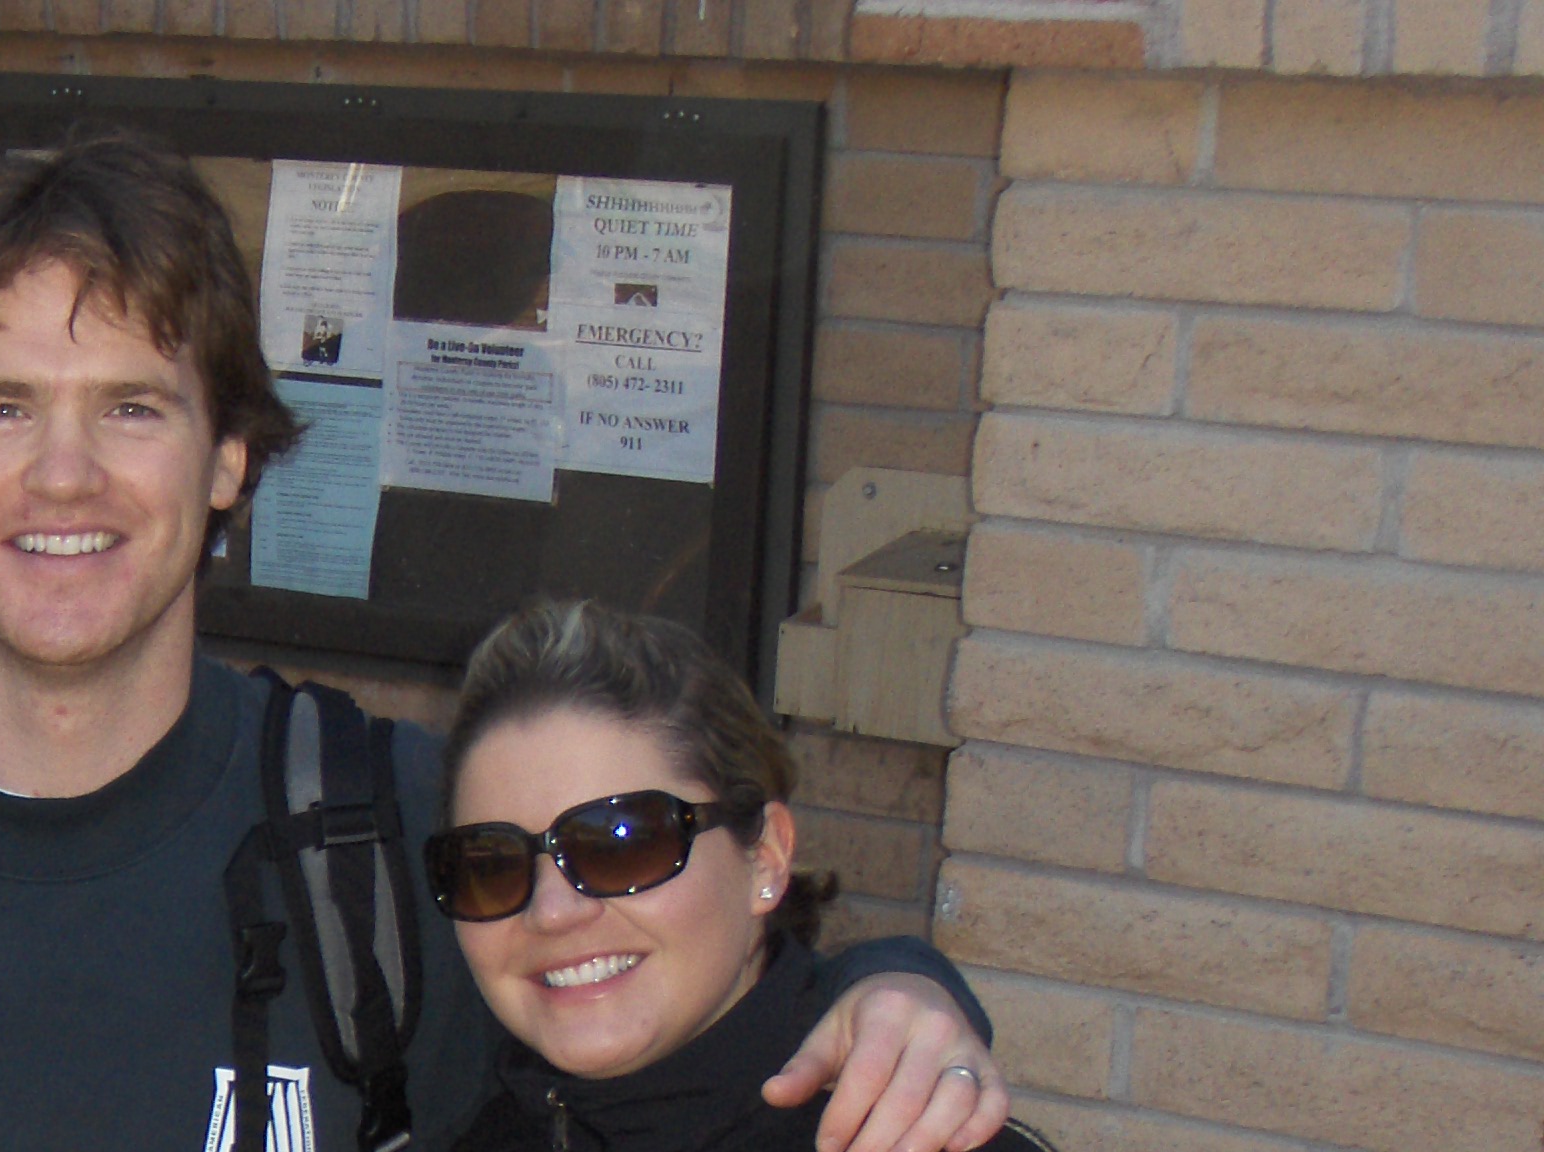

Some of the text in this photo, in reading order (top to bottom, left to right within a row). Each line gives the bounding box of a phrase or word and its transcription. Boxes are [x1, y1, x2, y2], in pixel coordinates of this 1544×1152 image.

[594, 217, 699, 238] QUIET TIME
[596, 244, 610, 260] 10
[614, 246, 638, 261] PM
[652, 248, 660, 262] 7
[664, 249, 690, 264] AM
[576, 323, 704, 350] EMERGENCY?
[615, 355, 656, 371] CALL
[587, 374, 619, 391] (805)
[654, 379, 684, 394] 2311
[579, 411, 690, 434] IF NO ANSWER
[620, 436, 643, 451] 911
